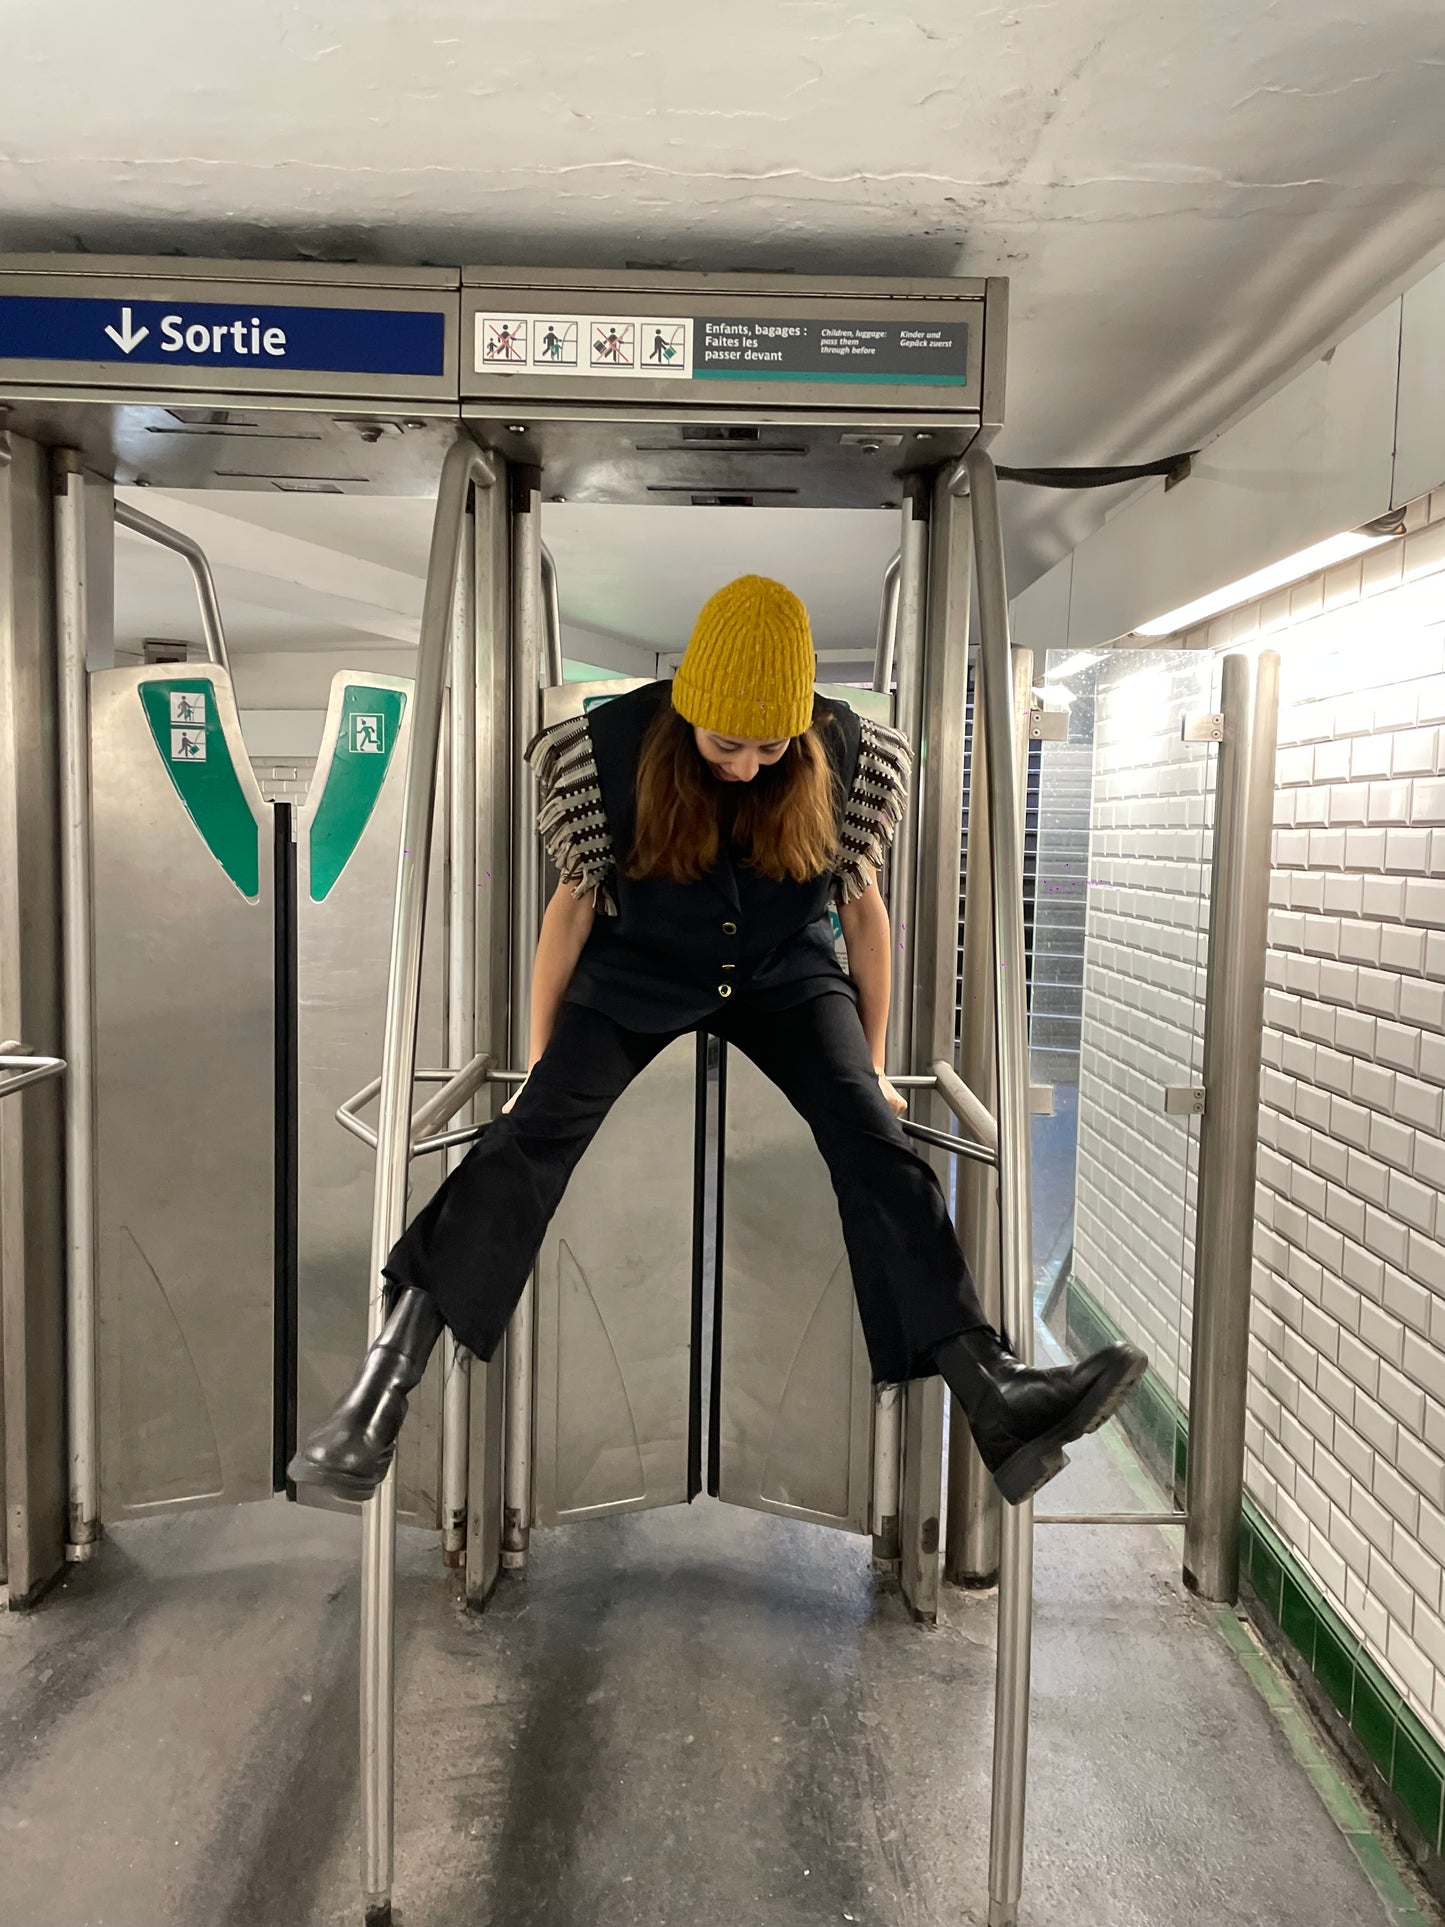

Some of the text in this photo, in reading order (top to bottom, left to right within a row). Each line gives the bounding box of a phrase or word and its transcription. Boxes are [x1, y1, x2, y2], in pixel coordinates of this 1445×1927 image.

[160, 315, 286, 356] Sortie
[705, 323, 752, 336] Enfants,
[755, 324, 801, 338] bagages
[821, 328, 887, 339] Children, luggage:
[900, 330, 941, 339] Kinder und
[705, 335, 758, 348] Faites les
[820, 338, 859, 346] pass them
[900, 338, 952, 348] Gepäck zuerst
[705, 349, 783, 361] passer devant
[820, 346, 876, 355] through before
